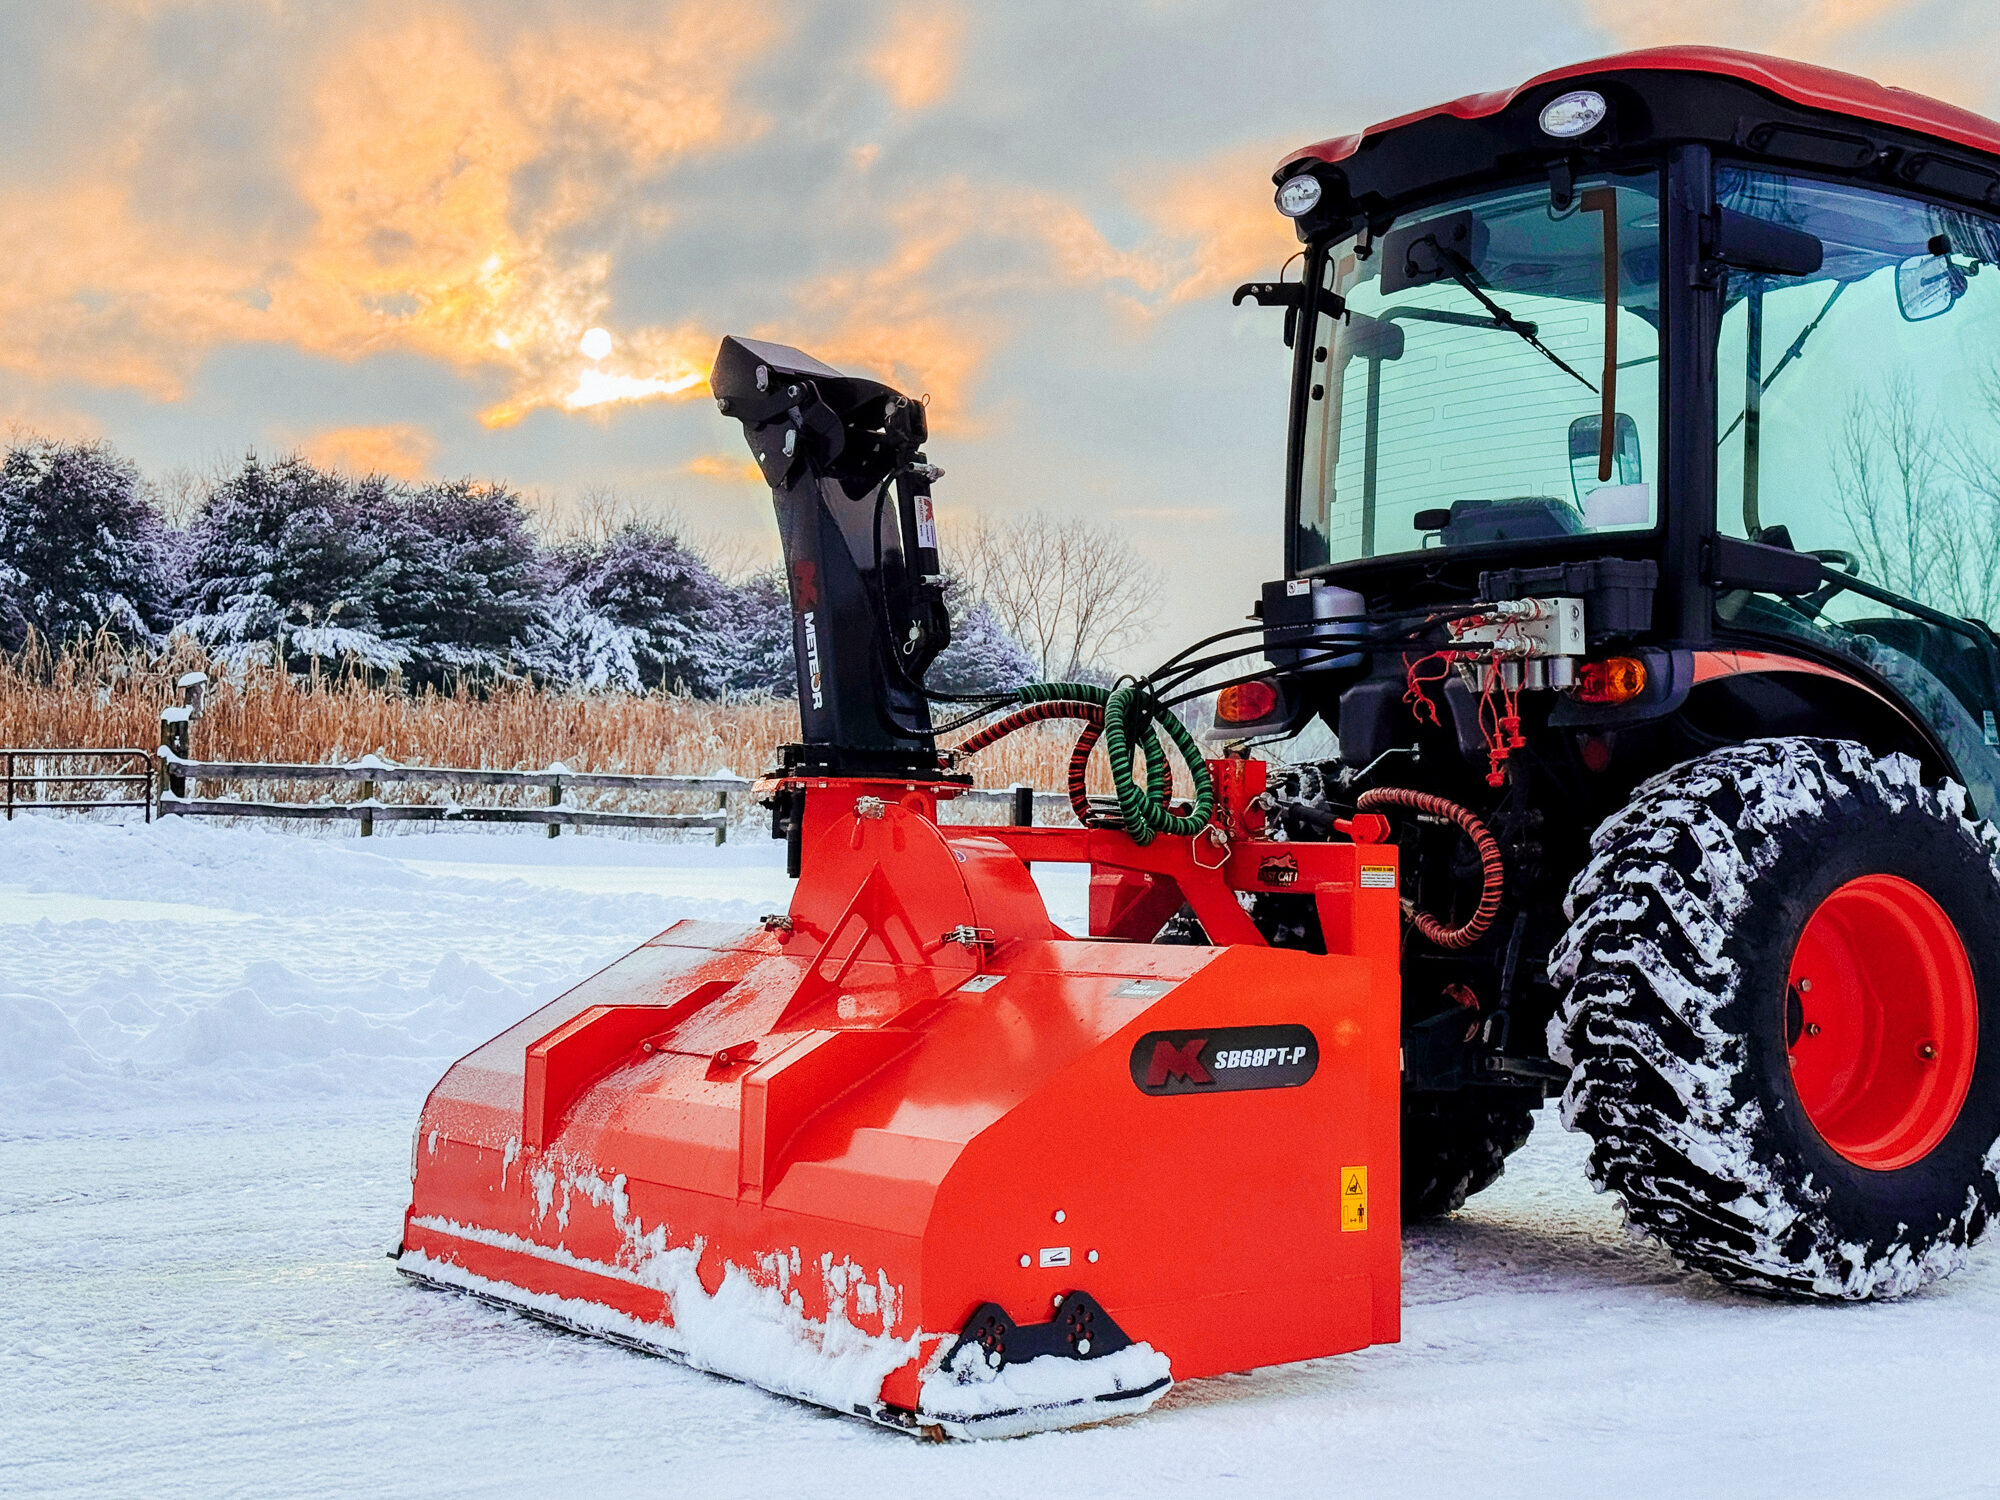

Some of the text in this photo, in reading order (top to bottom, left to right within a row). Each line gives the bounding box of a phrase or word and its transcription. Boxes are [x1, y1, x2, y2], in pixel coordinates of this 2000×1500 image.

[804, 612, 823, 710] METEOR
[1278, 871, 1294, 882] CAT
[1214, 1046, 1307, 1070] SB68PT-P
